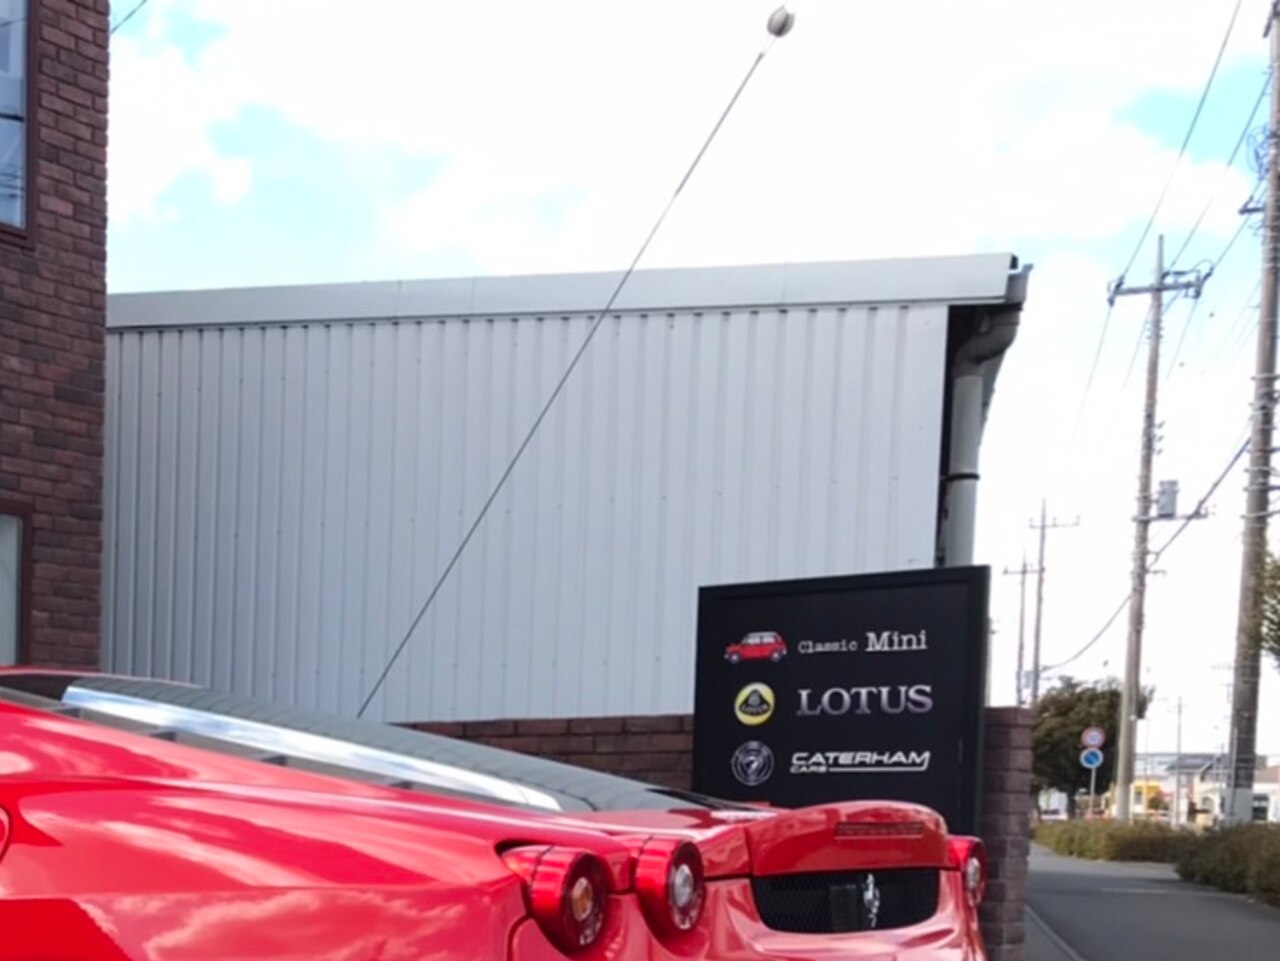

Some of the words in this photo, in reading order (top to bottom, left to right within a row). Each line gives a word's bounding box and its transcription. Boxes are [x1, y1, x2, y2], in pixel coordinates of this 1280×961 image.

[797, 639, 858, 654] Classic
[865, 629, 928, 652] Mini
[796, 684, 934, 716] LOTUS
[791, 750, 931, 766] CATERHAM
[790, 765, 828, 773] CARS
